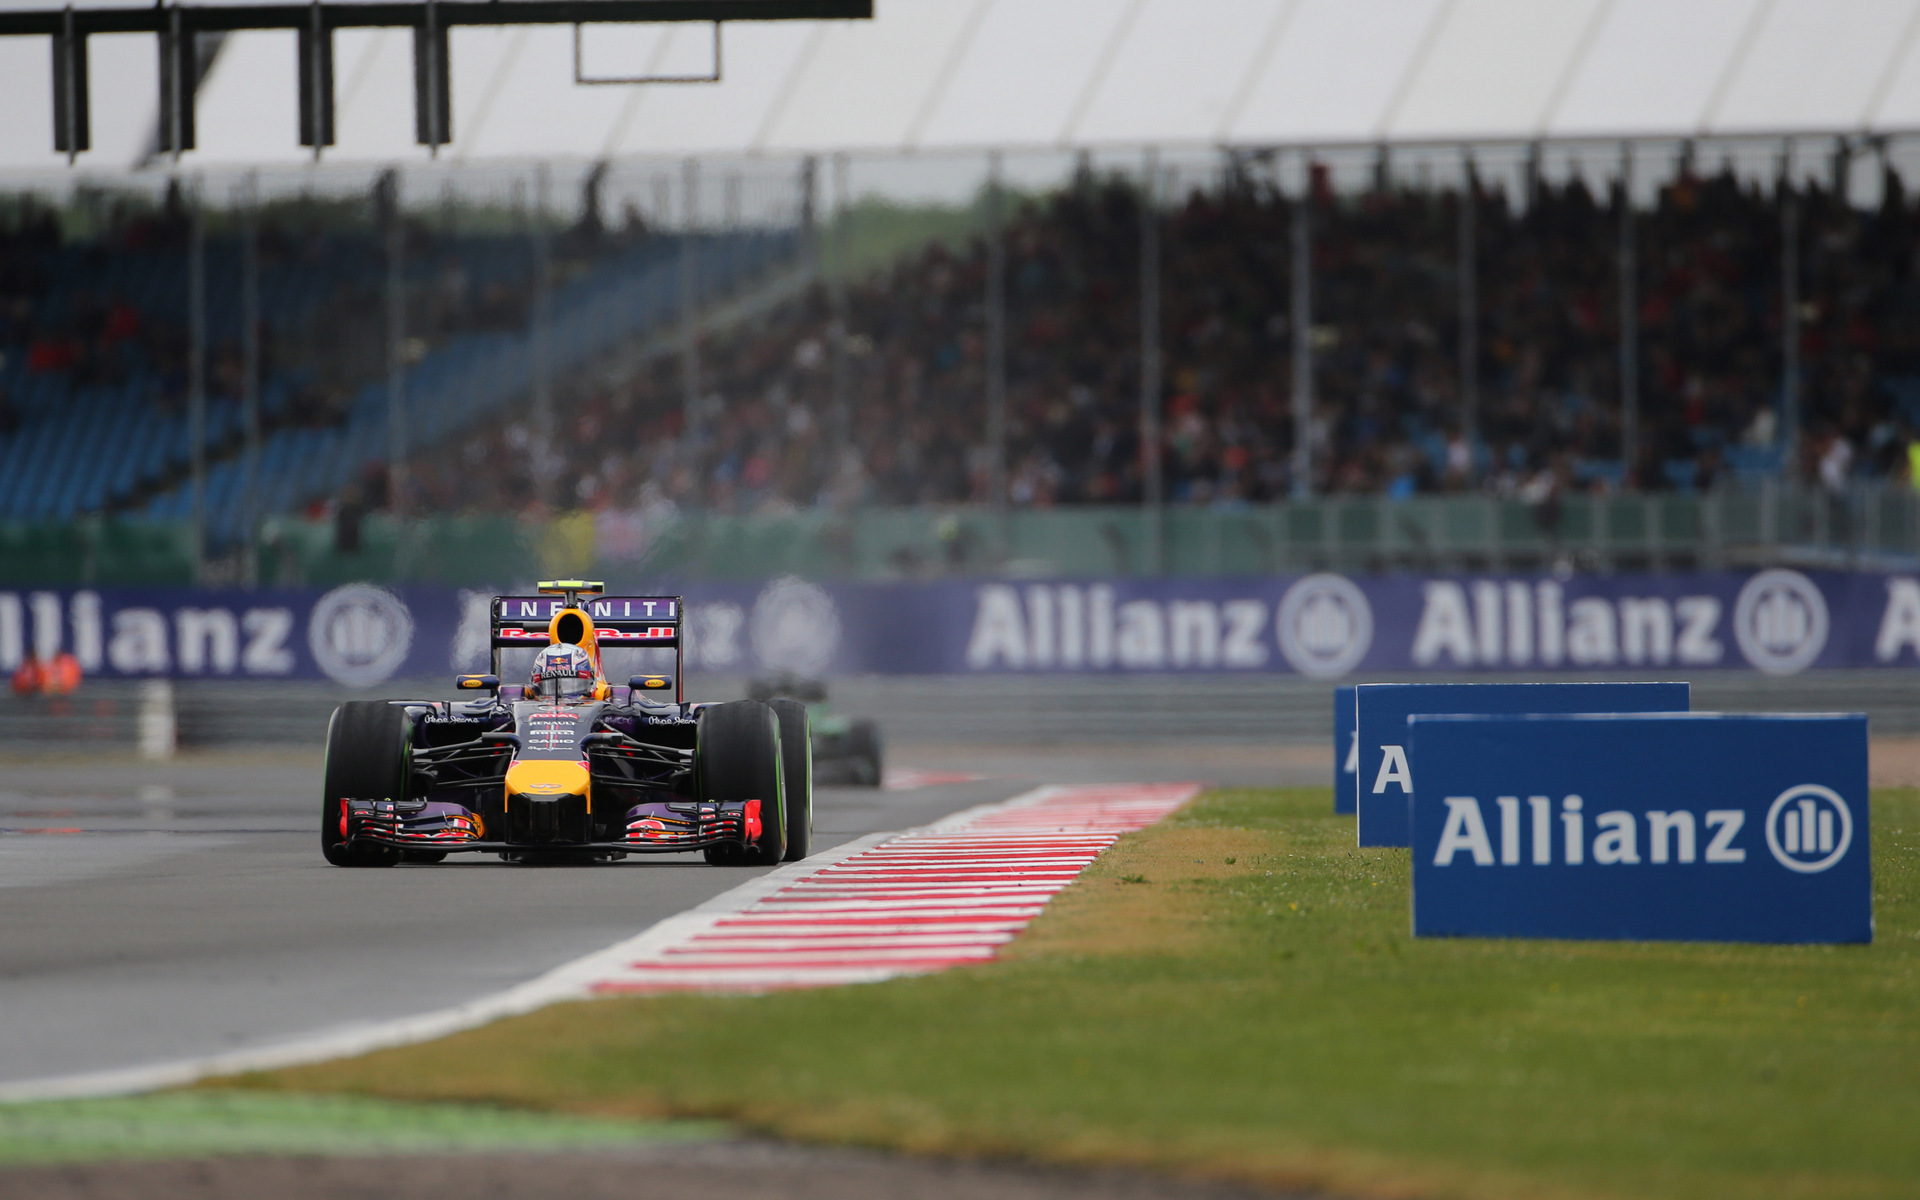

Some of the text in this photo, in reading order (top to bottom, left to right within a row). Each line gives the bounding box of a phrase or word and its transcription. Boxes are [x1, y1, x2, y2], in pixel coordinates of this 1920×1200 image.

[0, 588, 294, 676] llianz
[501, 601, 675, 616] INFNITI
[966, 582, 1270, 670] Allianz
[1411, 578, 1725, 667] Allianz
[541, 670, 577, 679] RENAULT
[450, 715, 479, 725] Jeans
[1433, 794, 1746, 866] Allianz
